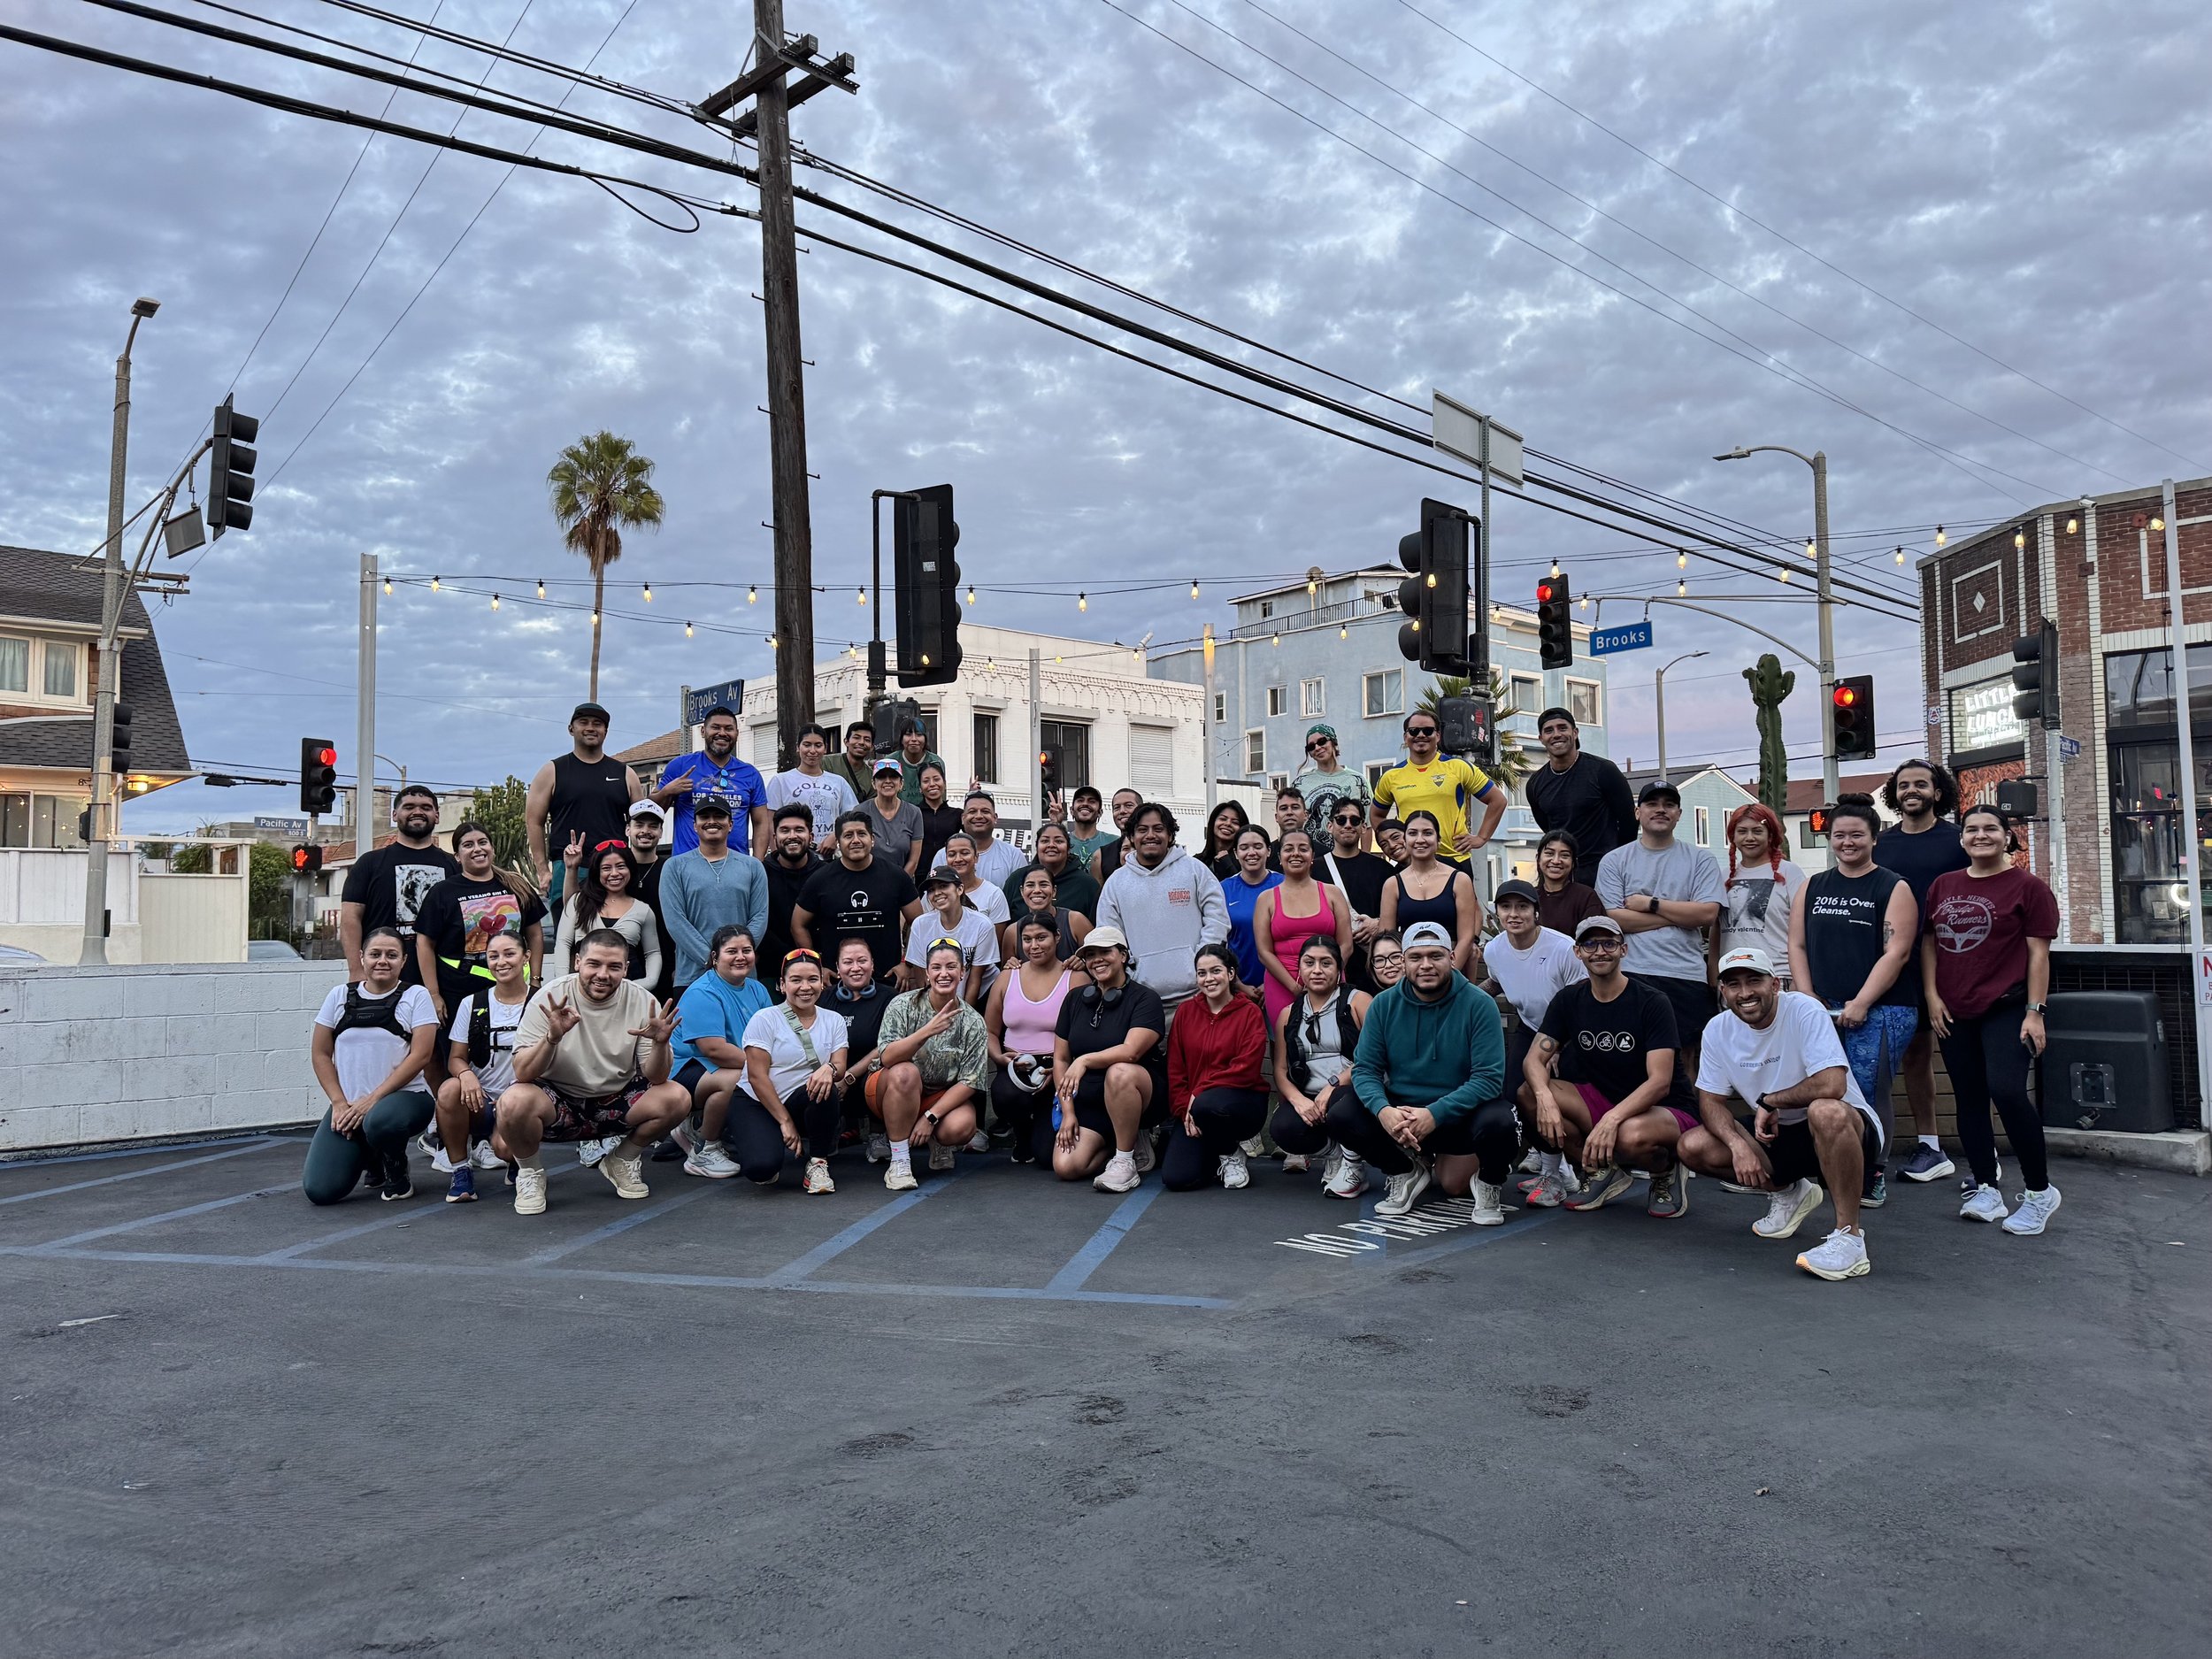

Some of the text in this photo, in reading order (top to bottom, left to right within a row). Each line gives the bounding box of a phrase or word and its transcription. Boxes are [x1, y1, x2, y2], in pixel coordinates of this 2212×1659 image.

[1596, 631, 1646, 649] Brooks
[690, 684, 738, 711] Brooks Av
[260, 818, 302, 829] Pacific Av
[1814, 896, 1876, 909] 2016 is Over.
[1966, 895, 1996, 910] HEIGHTS
[1812, 906, 1852, 916] Cleanse.
[1940, 904, 1975, 916] Bridge
[1947, 914, 1987, 926] Runners
[1273, 1233, 1380, 1258] NO
